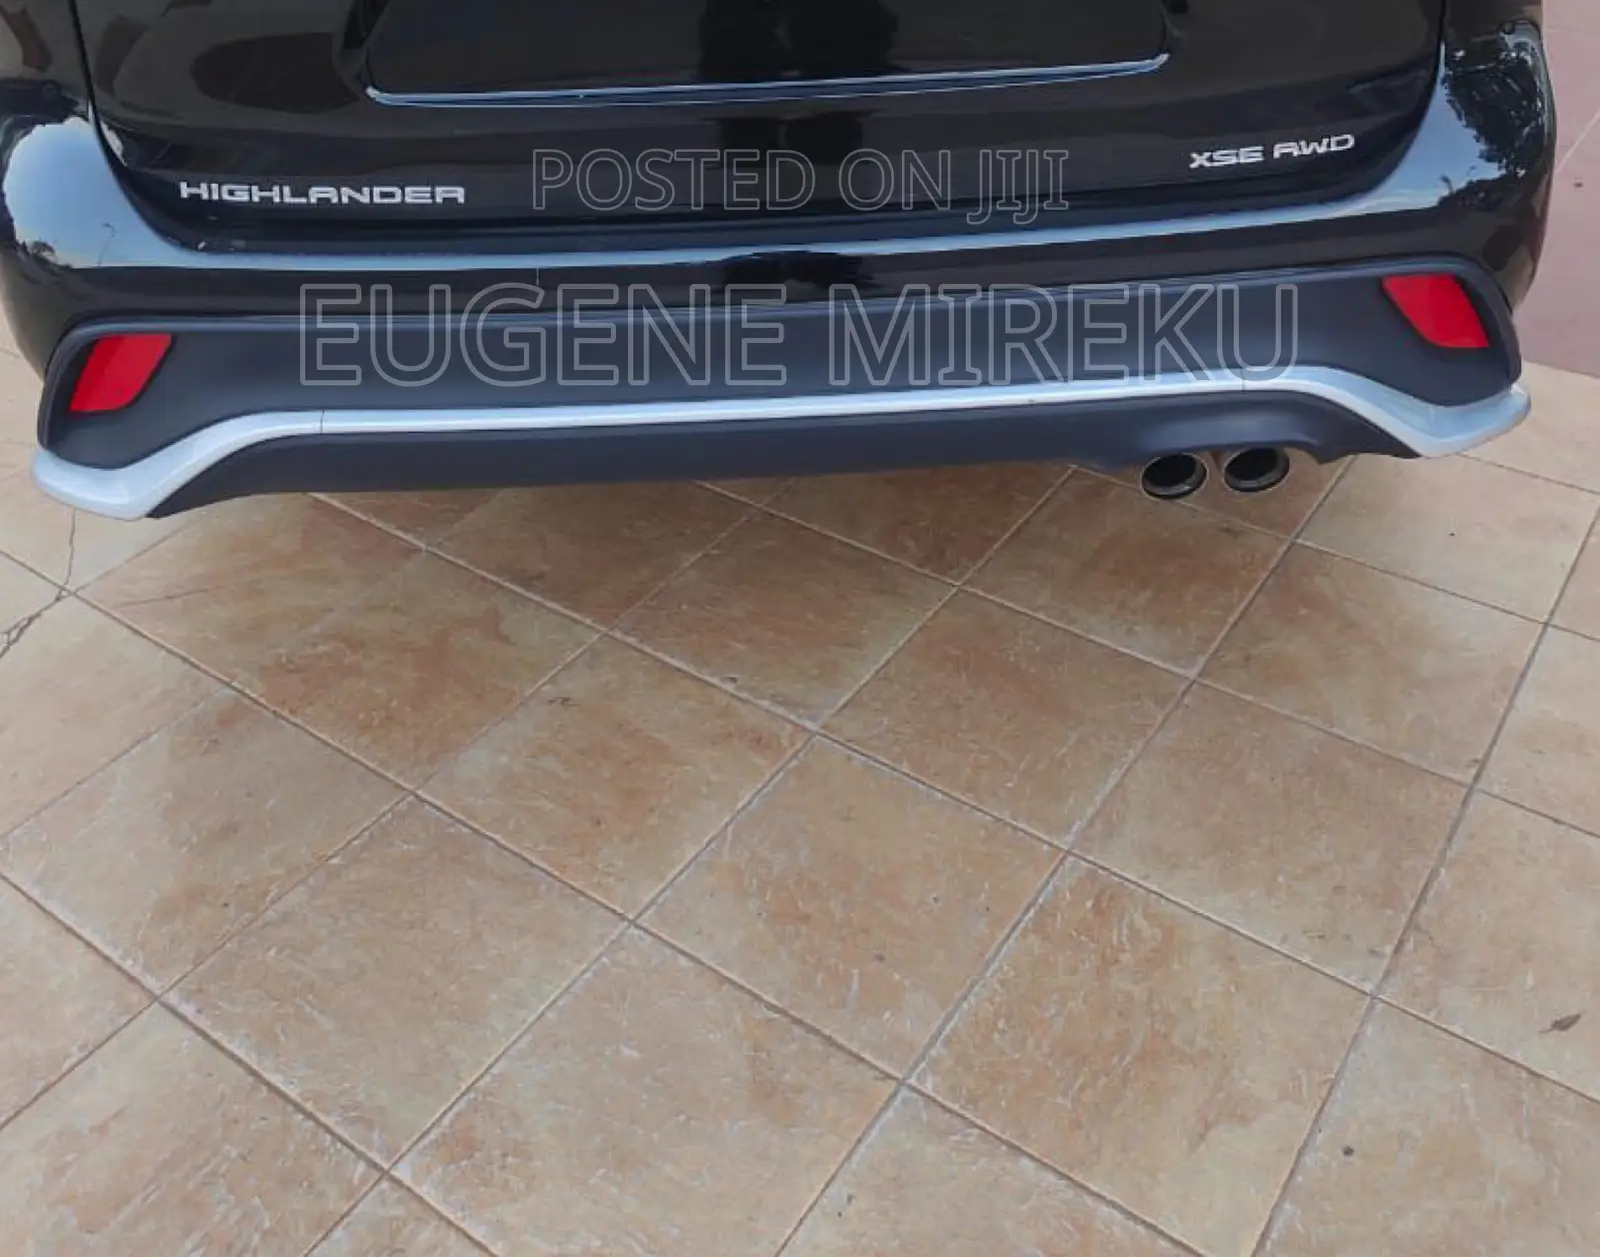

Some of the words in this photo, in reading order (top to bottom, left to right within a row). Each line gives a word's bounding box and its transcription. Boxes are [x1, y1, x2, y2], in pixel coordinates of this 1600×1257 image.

[1189, 145, 1265, 169] XSE
[1272, 133, 1356, 159] AWD
[178, 181, 466, 204] HIGHLANDER
